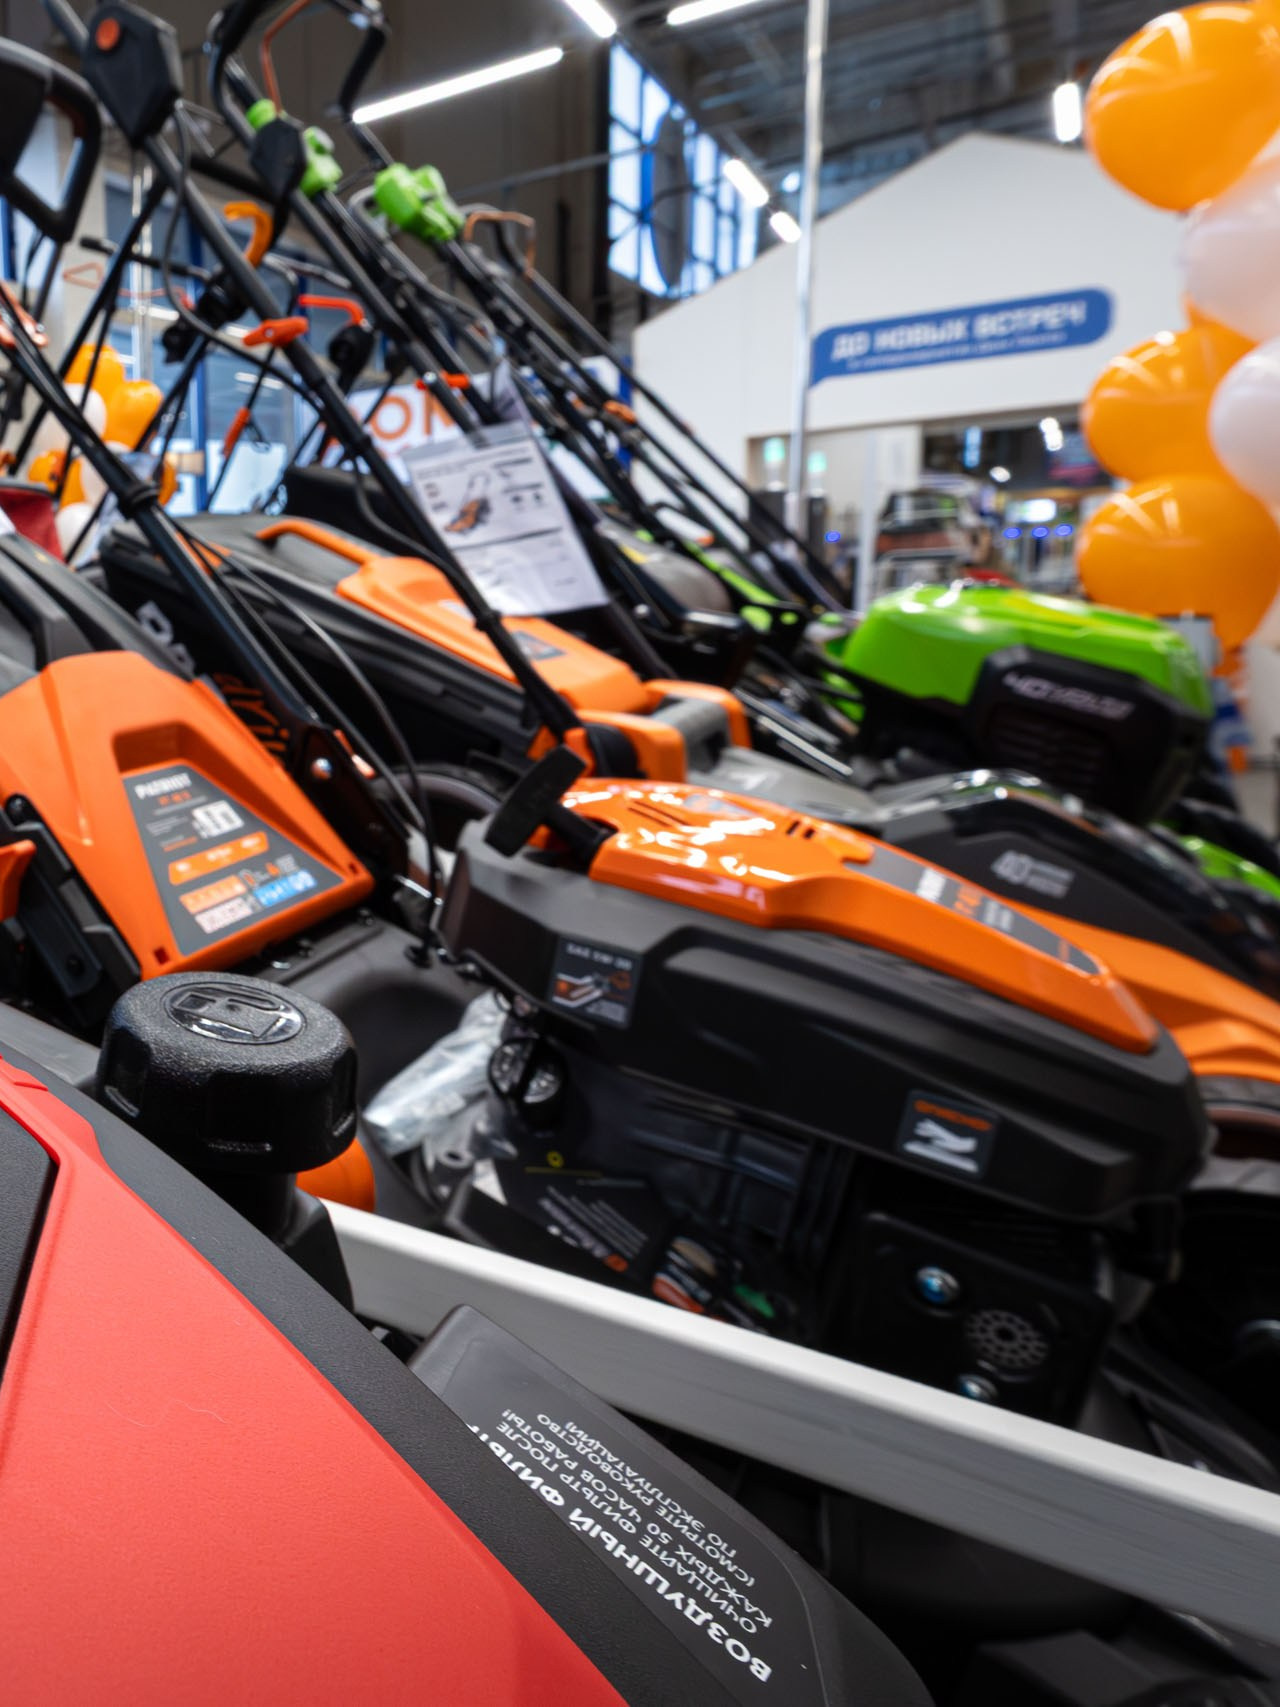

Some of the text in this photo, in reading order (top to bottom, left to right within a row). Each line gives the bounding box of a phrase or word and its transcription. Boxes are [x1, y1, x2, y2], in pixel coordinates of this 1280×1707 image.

[496, 1421, 758, 1634] ОЧИЩАЙТЕ ФИЛЬТР ПОСЛЕ
[501, 1409, 773, 1628] КАЖДЫХ 50 ЧАСОВ РАБОТЫ!
[536, 1413, 756, 1588] (СМОТРИТЕ РУКОВОДСТВО
[564, 1421, 737, 1559] ПО ЭКСПЛУАТАЦИИ)
[569, 1508, 772, 1683] ВОЗДУШНЫЙ
